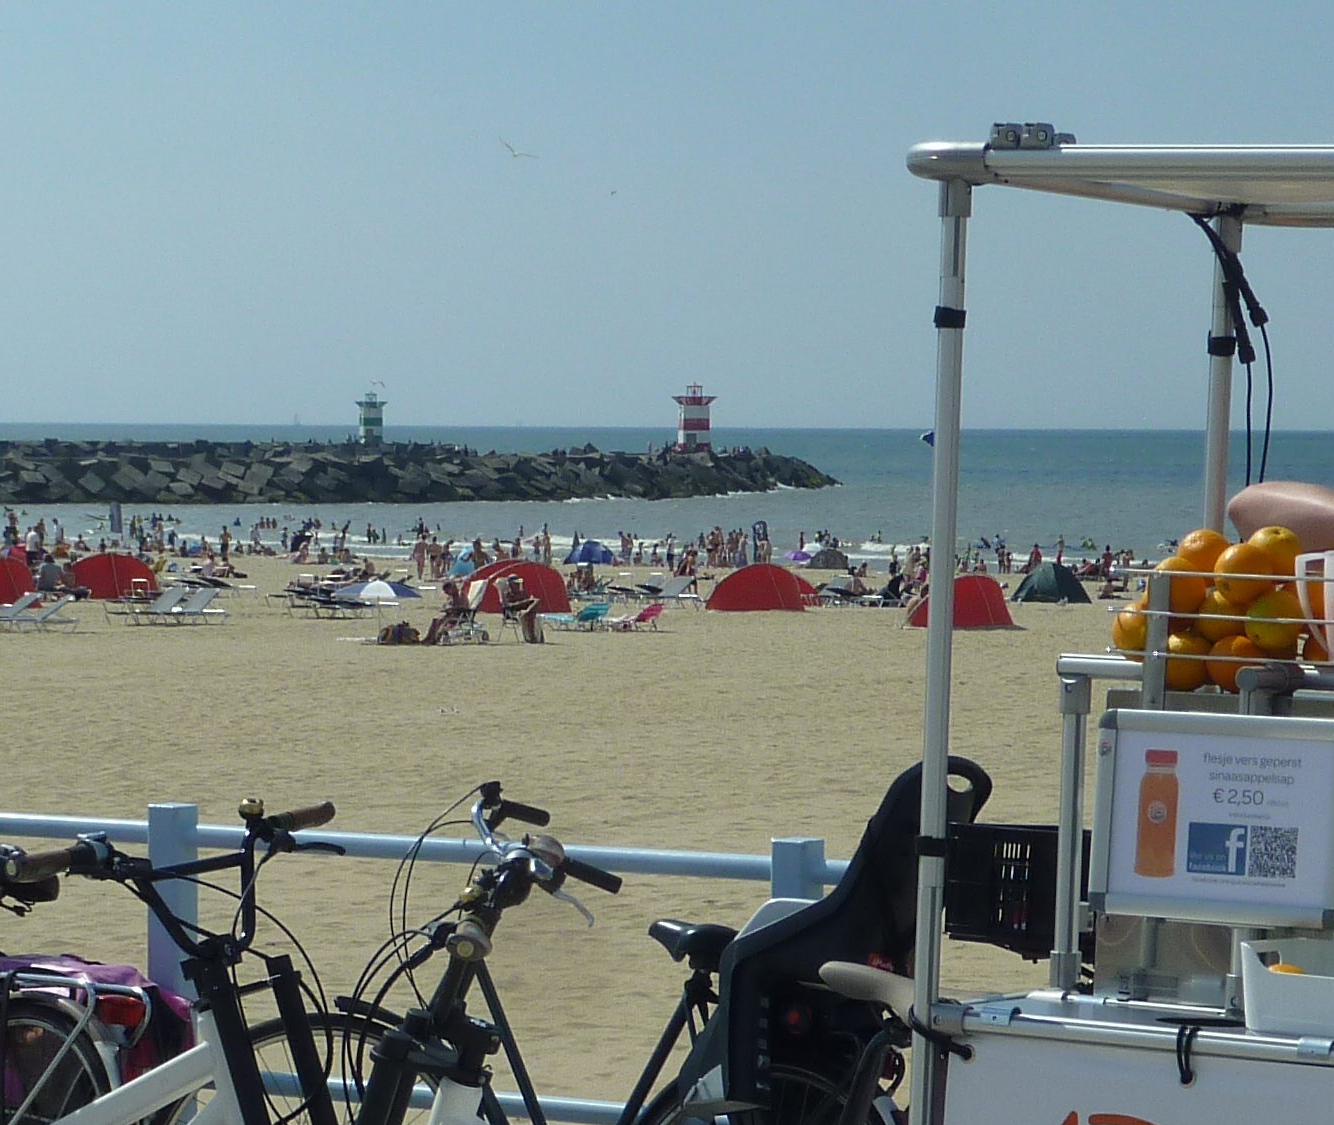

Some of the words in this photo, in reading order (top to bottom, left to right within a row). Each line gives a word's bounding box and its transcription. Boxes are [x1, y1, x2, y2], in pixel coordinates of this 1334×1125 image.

[1234, 756, 1258, 766] vers
[1259, 757, 1302, 768] geperst
[1212, 788, 1225, 803] €
[1227, 789, 1264, 807] 2,50
